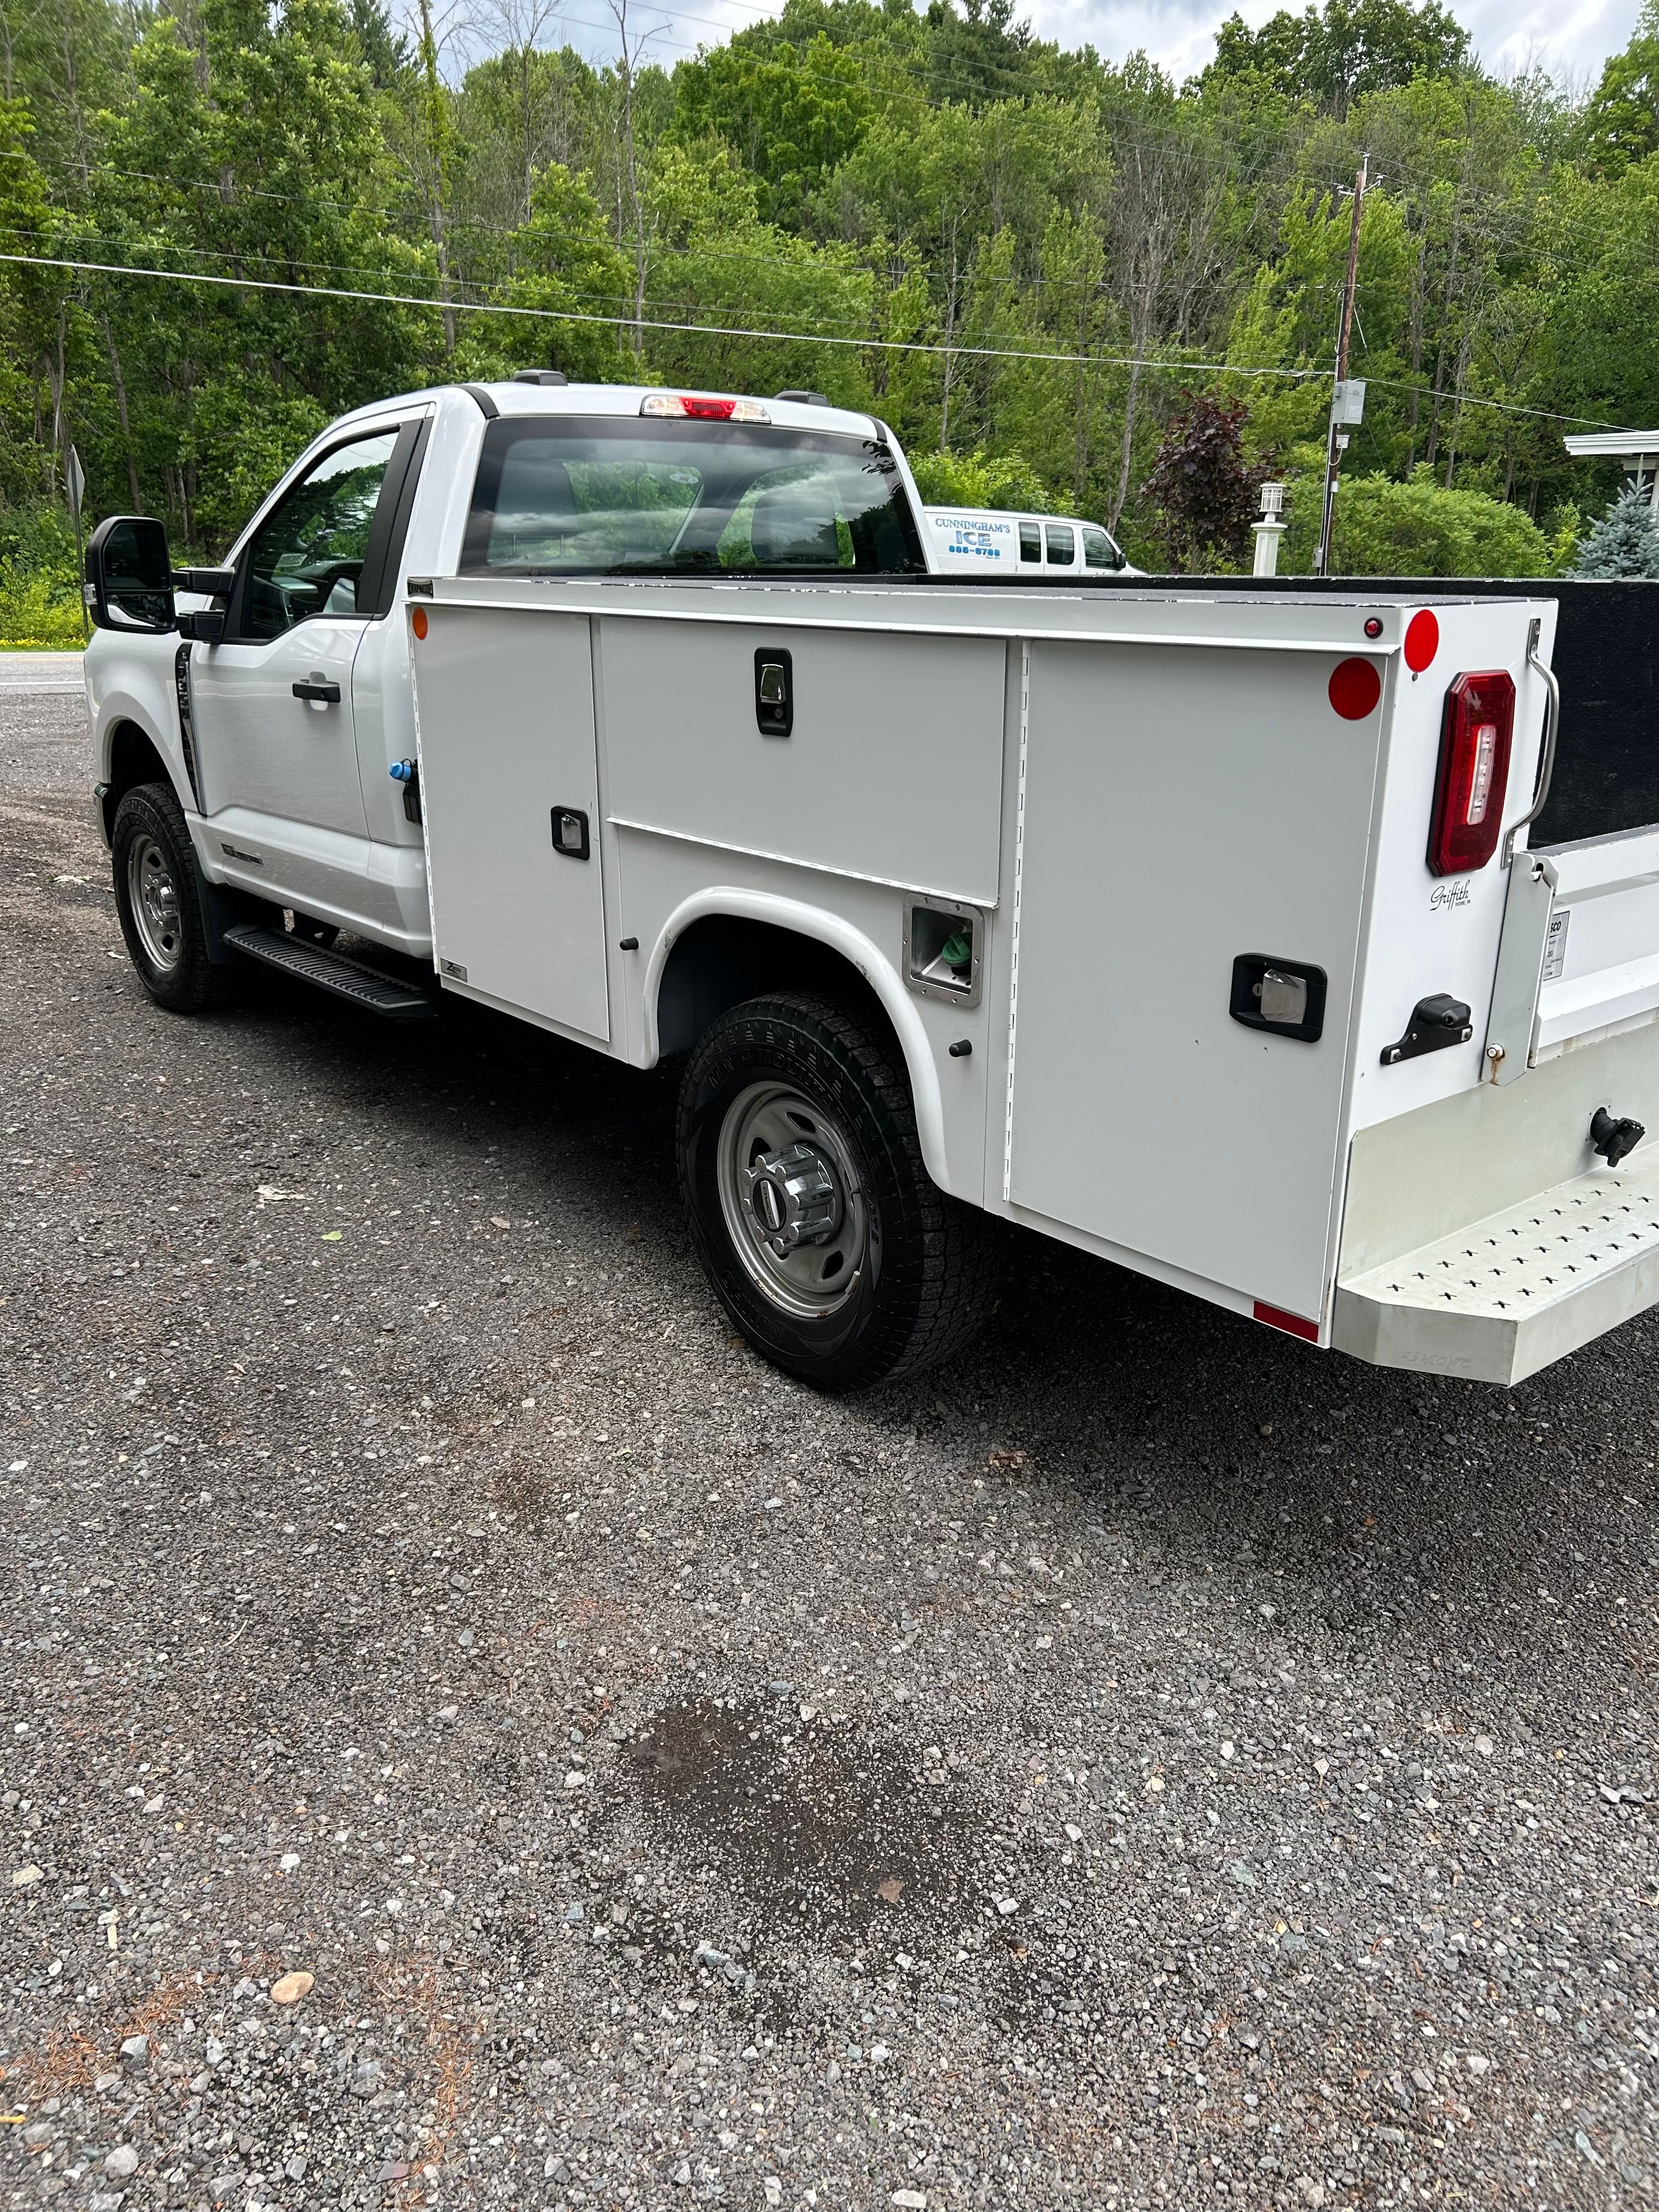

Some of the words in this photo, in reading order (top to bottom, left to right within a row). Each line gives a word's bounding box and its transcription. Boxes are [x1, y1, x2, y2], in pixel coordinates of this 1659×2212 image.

[935, 518, 1010, 533] CUNNINGHAM'S
[956, 531, 992, 546] ICE
[1429, 879, 1470, 911] Griffith
[763, 1186, 774, 1224] FORD
